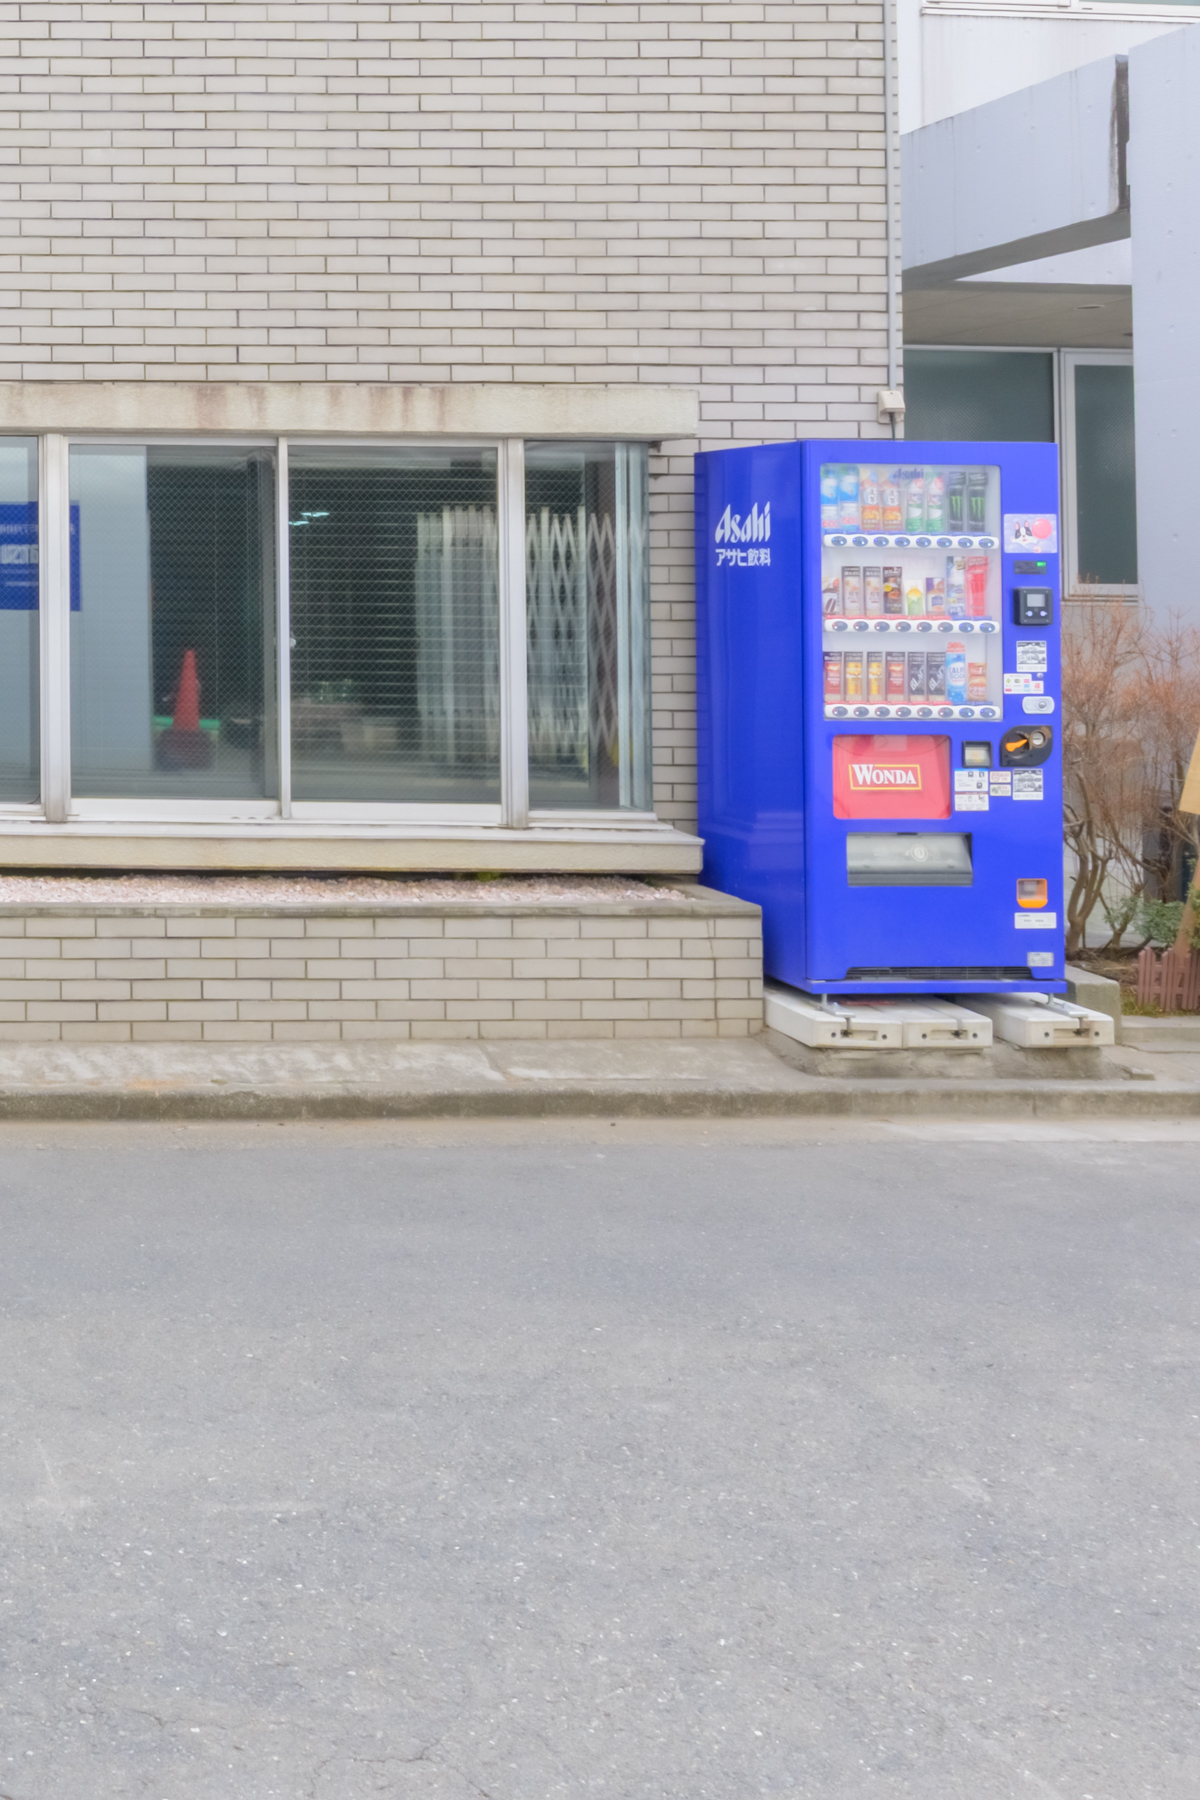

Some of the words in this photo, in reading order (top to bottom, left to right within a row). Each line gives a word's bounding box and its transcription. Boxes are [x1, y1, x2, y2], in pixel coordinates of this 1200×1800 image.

[715, 501, 770, 543] Asahi
[715, 548, 771, 566] アサヒ飲料
[852, 764, 917, 785] WONDA
